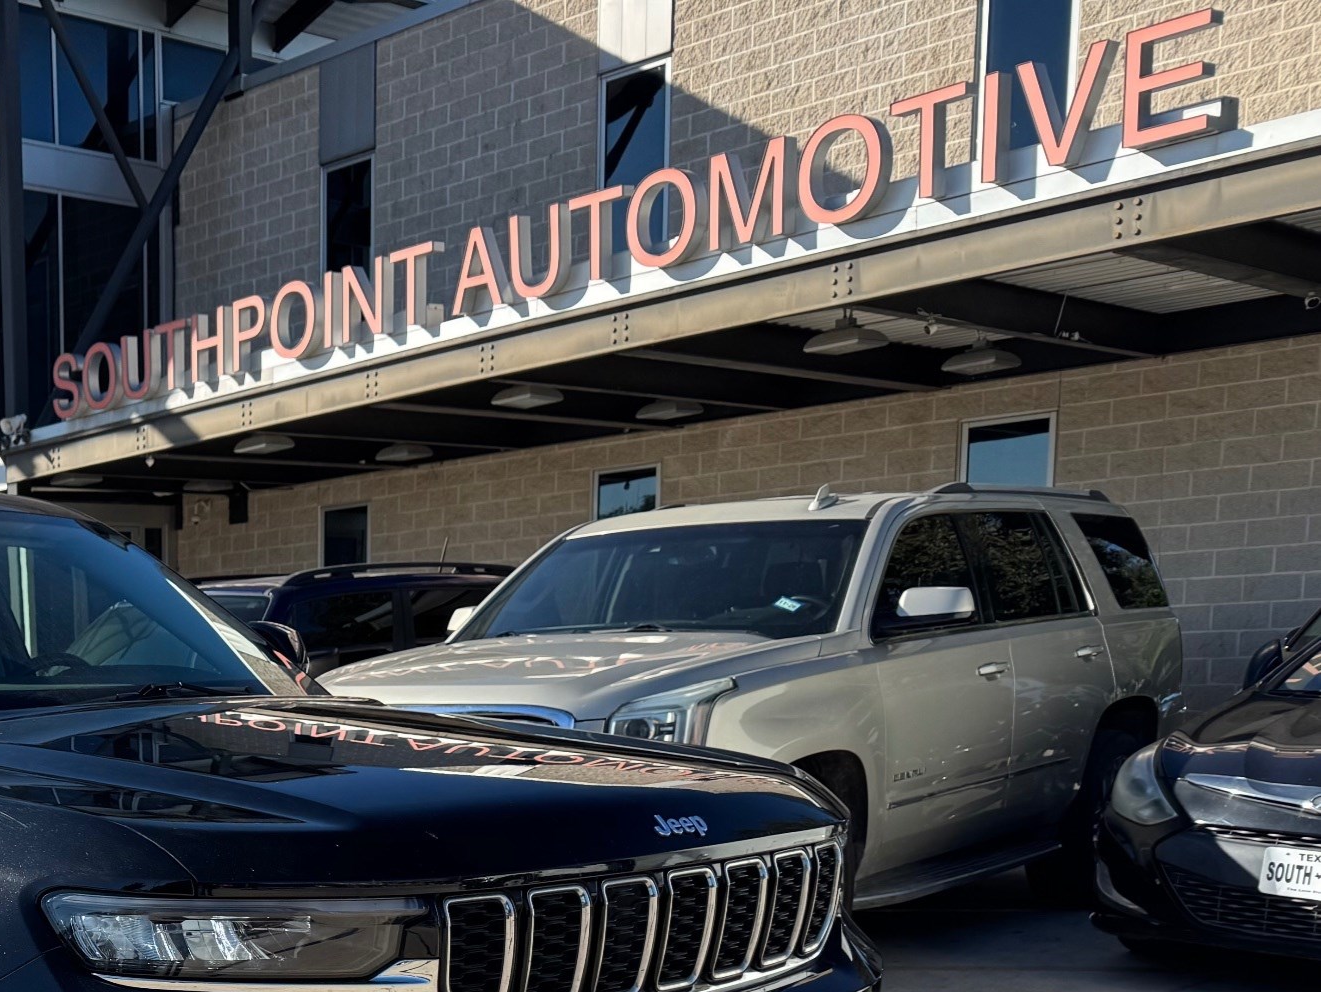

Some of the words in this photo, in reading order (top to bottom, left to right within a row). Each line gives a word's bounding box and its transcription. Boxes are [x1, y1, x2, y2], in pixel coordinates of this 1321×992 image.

[52, 240, 438, 419] SOUTHPOINT
[452, 8, 1226, 316] AUTOMOTIVE
[653, 814, 708, 837] Jeep
[1266, 861, 1314, 886] SOUTH
